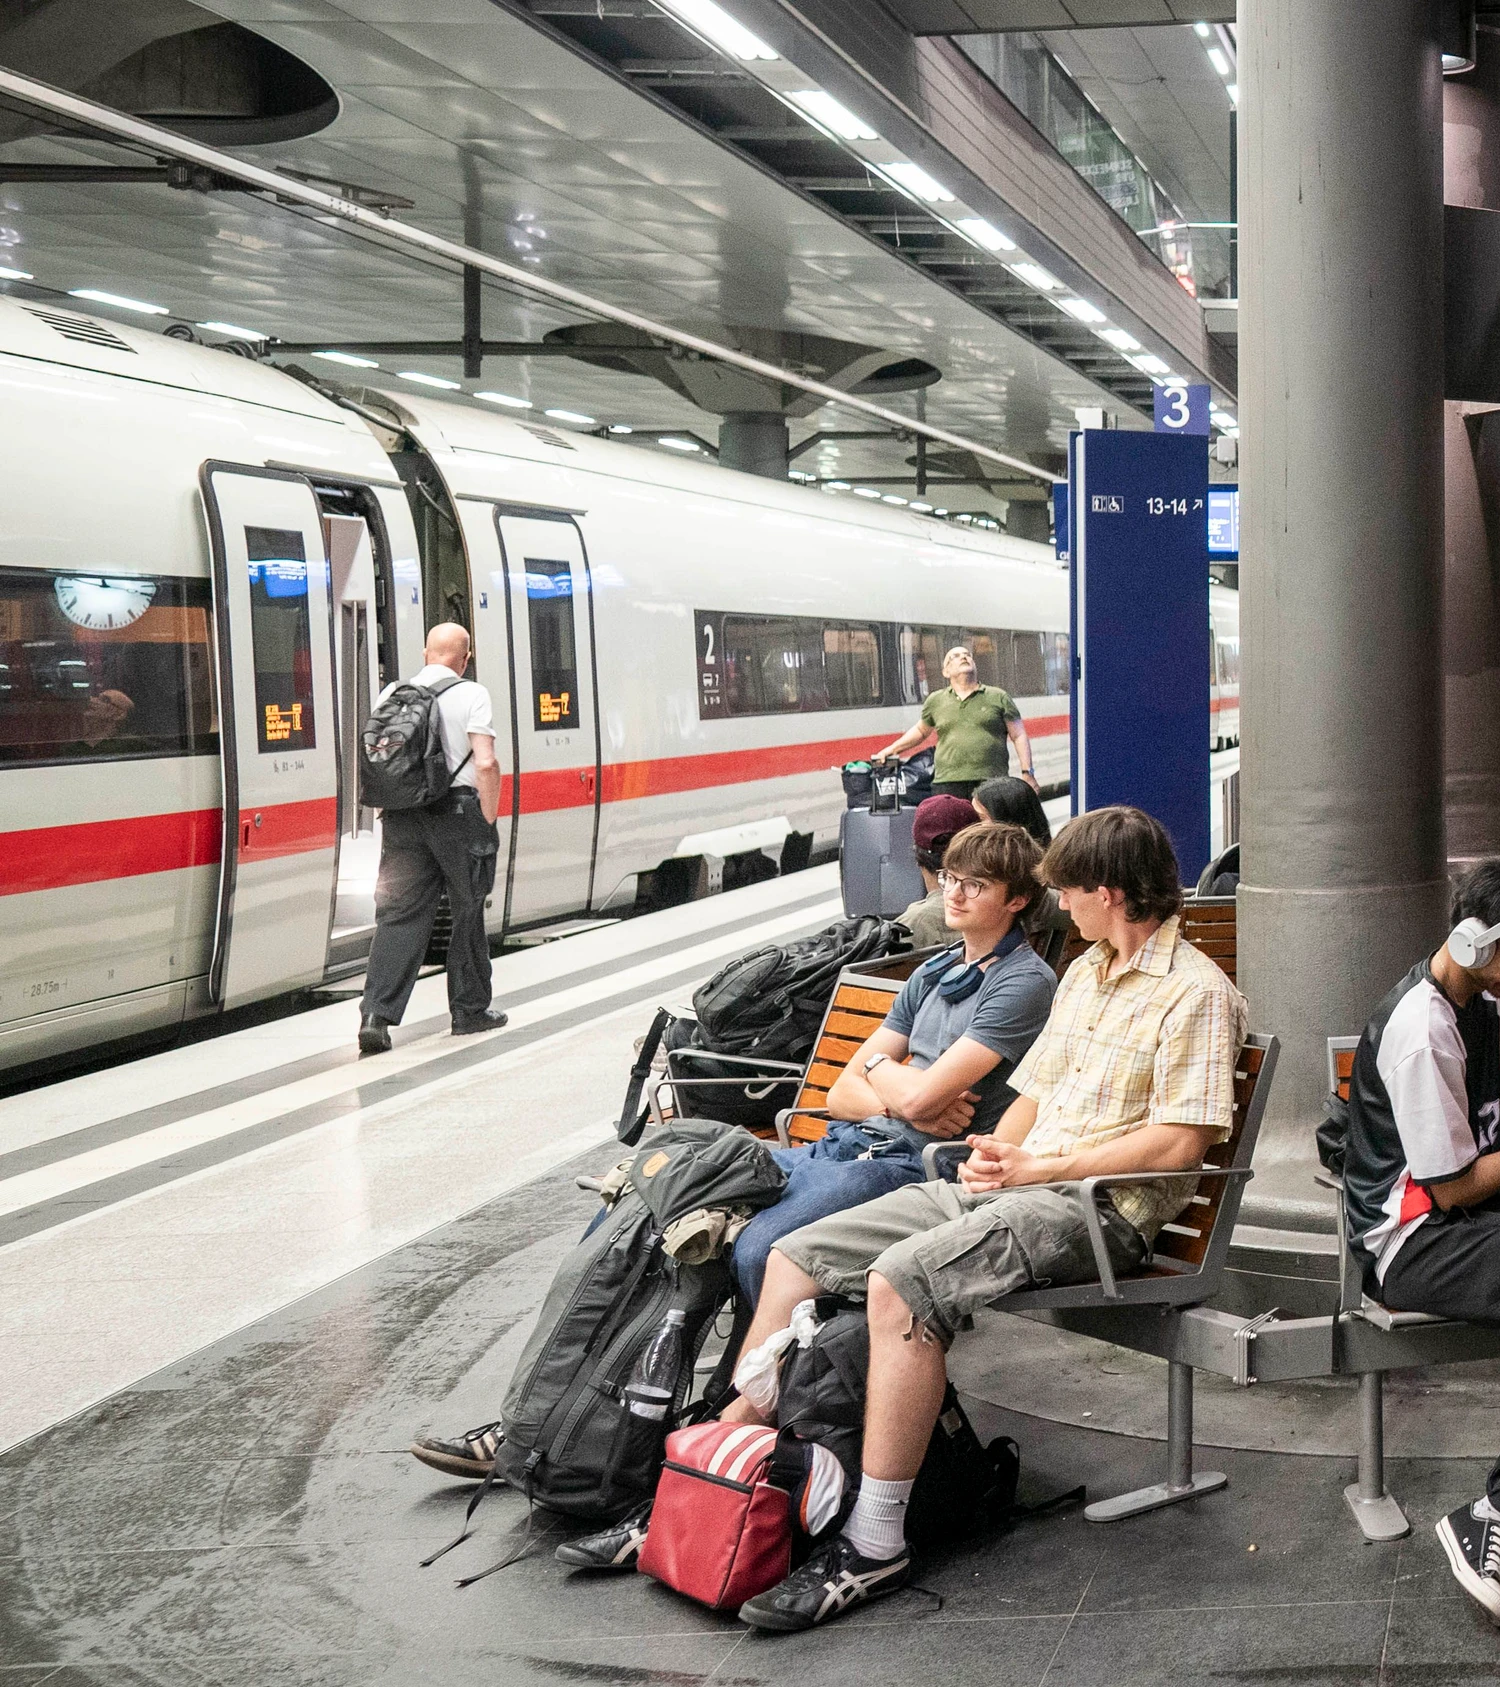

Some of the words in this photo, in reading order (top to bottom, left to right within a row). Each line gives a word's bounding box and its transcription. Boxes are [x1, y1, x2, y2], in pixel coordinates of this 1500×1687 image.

[1162, 387, 1190, 428] 3
[1146, 497, 1187, 515] 13-14
[703, 624, 716, 665] 2
